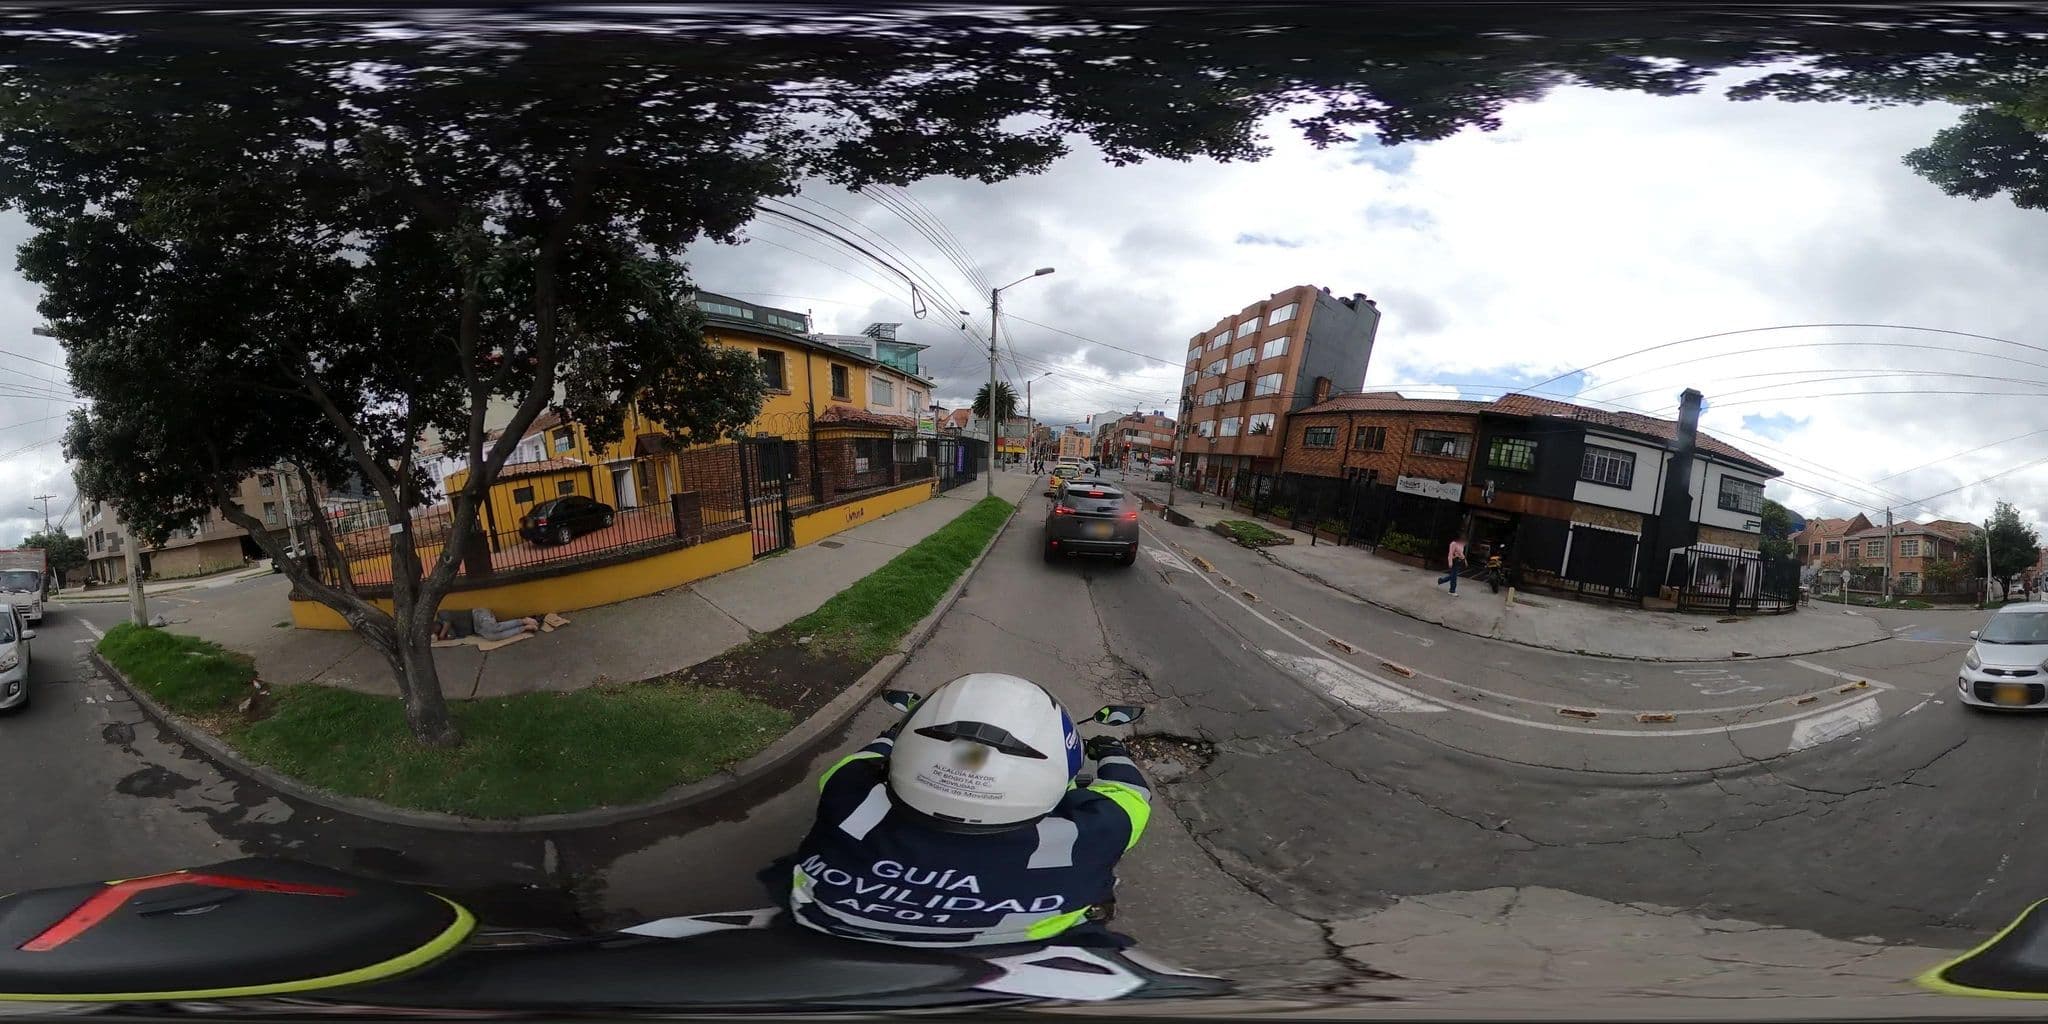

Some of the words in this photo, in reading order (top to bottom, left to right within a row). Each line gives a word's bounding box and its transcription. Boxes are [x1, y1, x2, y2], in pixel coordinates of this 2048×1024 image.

[801, 854, 1065, 913] MOVILIDAD
[871, 860, 980, 894] GUÍA
[835, 898, 951, 924] AF01
